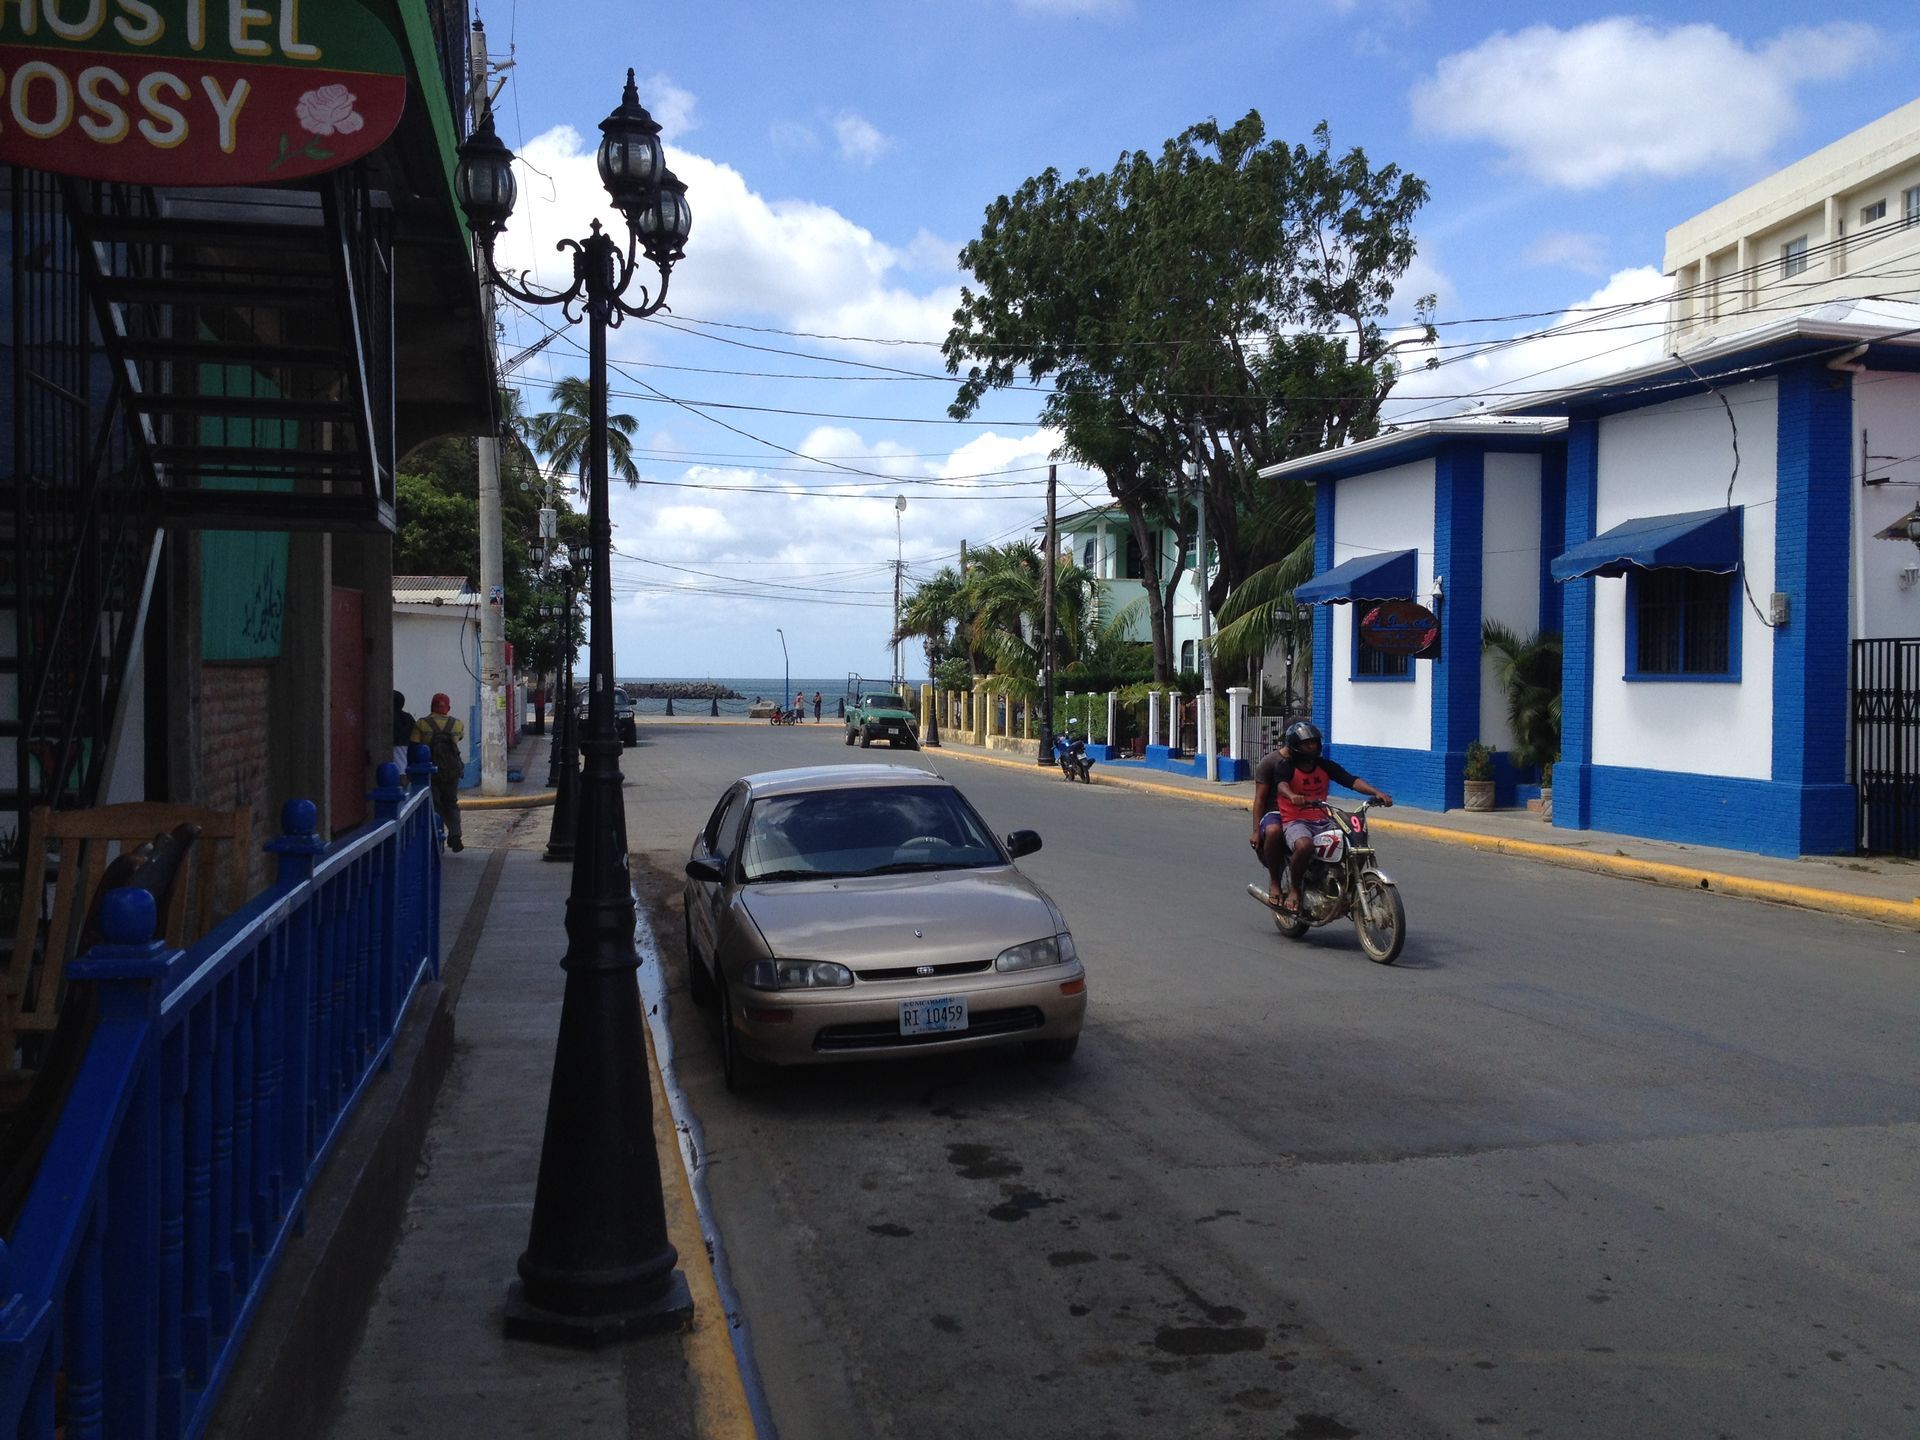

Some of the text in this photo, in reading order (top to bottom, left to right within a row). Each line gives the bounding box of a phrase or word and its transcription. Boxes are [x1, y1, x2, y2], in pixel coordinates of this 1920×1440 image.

[0, 61, 251, 153] OSSY
[904, 1005, 963, 1027] RI 10459
